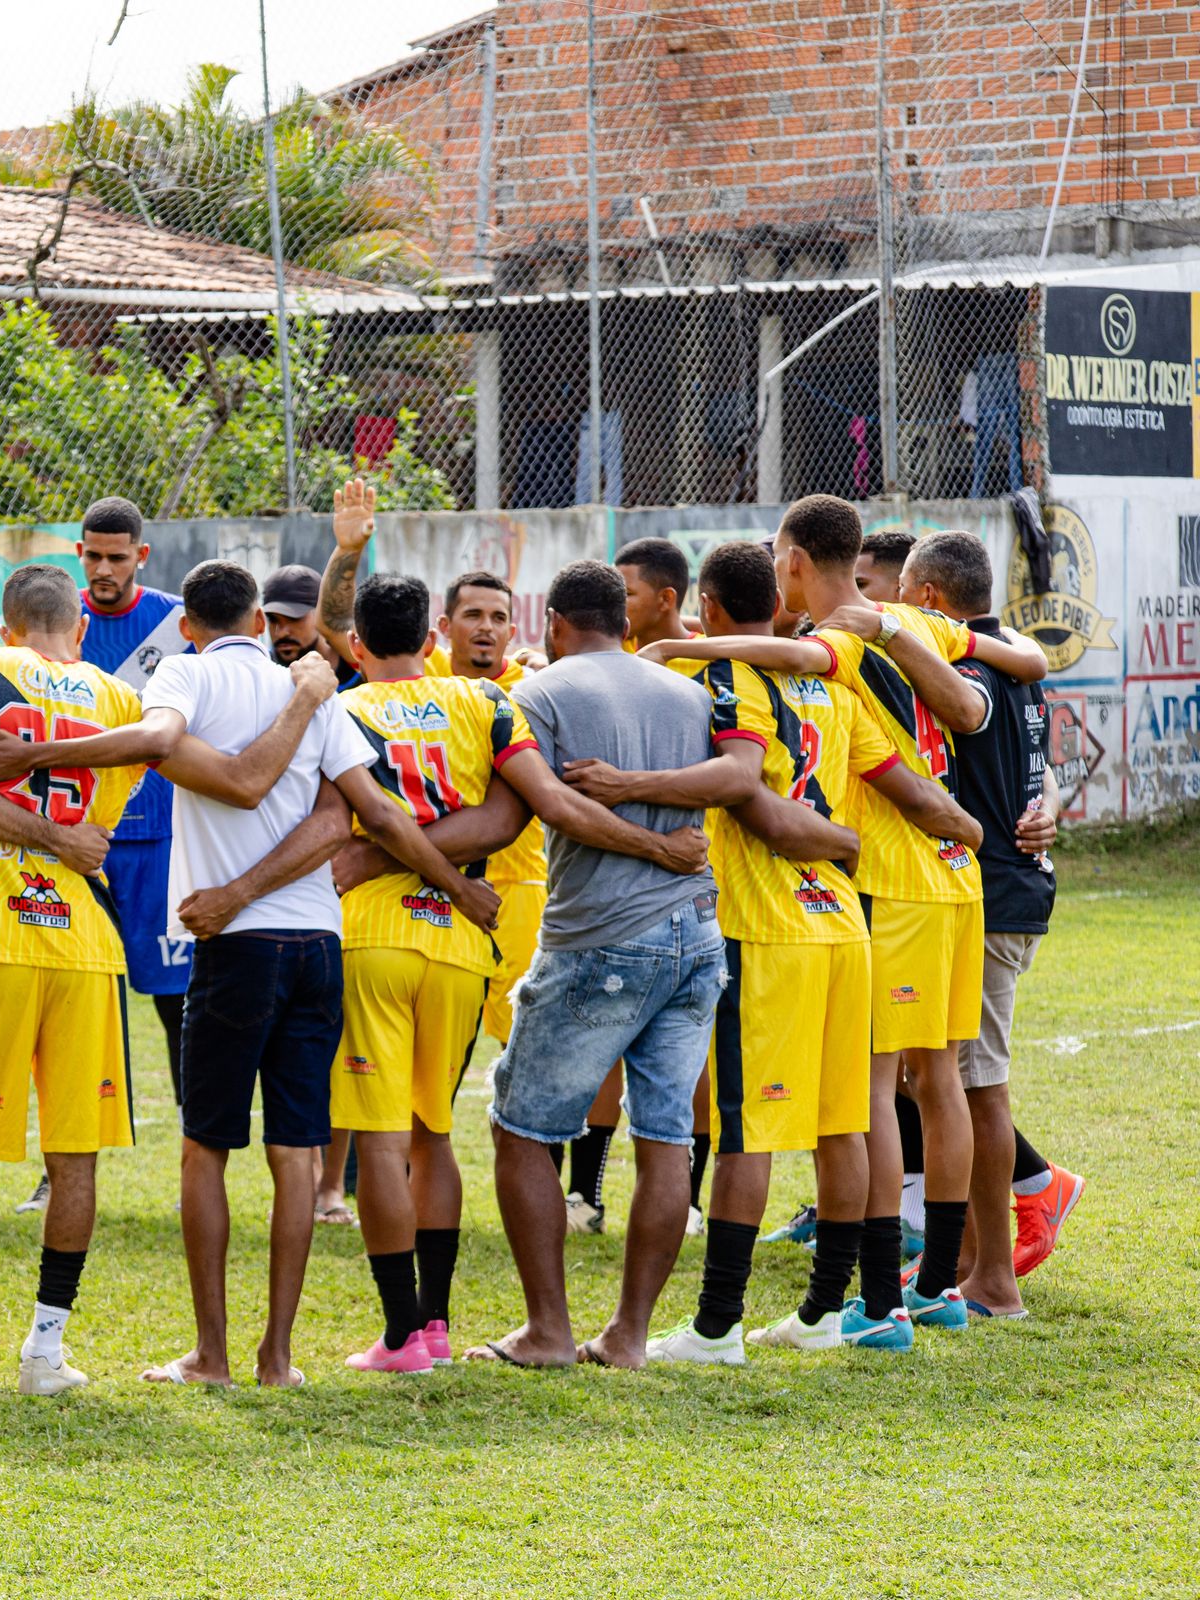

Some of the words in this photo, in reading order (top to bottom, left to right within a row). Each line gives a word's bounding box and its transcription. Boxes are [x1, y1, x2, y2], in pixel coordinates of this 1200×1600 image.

[1046, 353, 1072, 400] DR
[1070, 355, 1148, 403] WENNER
[1150, 360, 1192, 406] COSTA
[1067, 405, 1123, 427] ODONTOLOGIA
[1010, 602, 1041, 633] LEO
[1043, 598, 1060, 622] DE
[1062, 602, 1094, 635] PIBE
[384, 740, 463, 826] 11
[9, 896, 70, 917] WEDSON
[21, 912, 67, 927] MOTOS
[157, 935, 189, 967] 12
